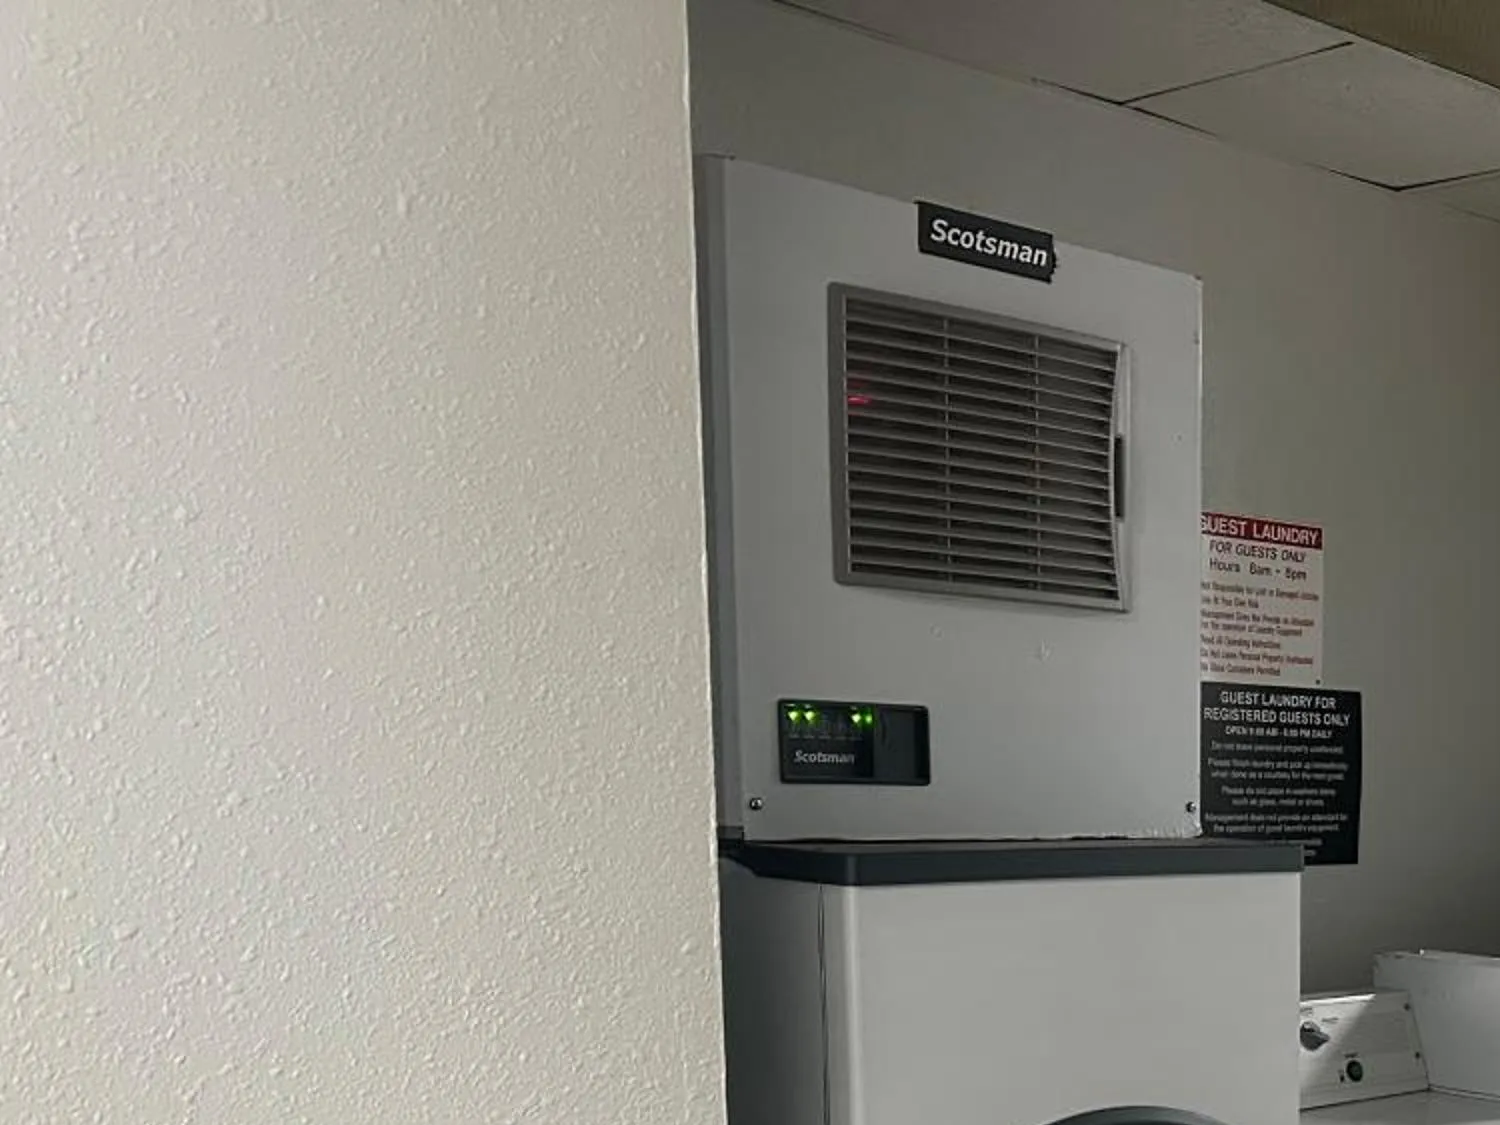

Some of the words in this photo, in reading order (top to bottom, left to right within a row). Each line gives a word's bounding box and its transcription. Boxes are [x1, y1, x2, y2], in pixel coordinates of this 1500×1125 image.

[930, 219, 1048, 266] Scotsman
[1253, 521, 1319, 545] LAUNDRY
[1209, 540, 1232, 553] FOR
[1236, 543, 1277, 560] GUESTS
[1281, 549, 1306, 563] ONLY
[1209, 558, 1240, 572] Hours
[1220, 691, 1259, 706] GUEST
[1262, 693, 1313, 709] LAUNDRY
[1314, 696, 1336, 710] FOR
[1203, 707, 1277, 723] REGISTERED
[1279, 711, 1321, 726] GUESTS
[1323, 713, 1350, 727] ONLY
[794, 749, 855, 765] Scotsman
